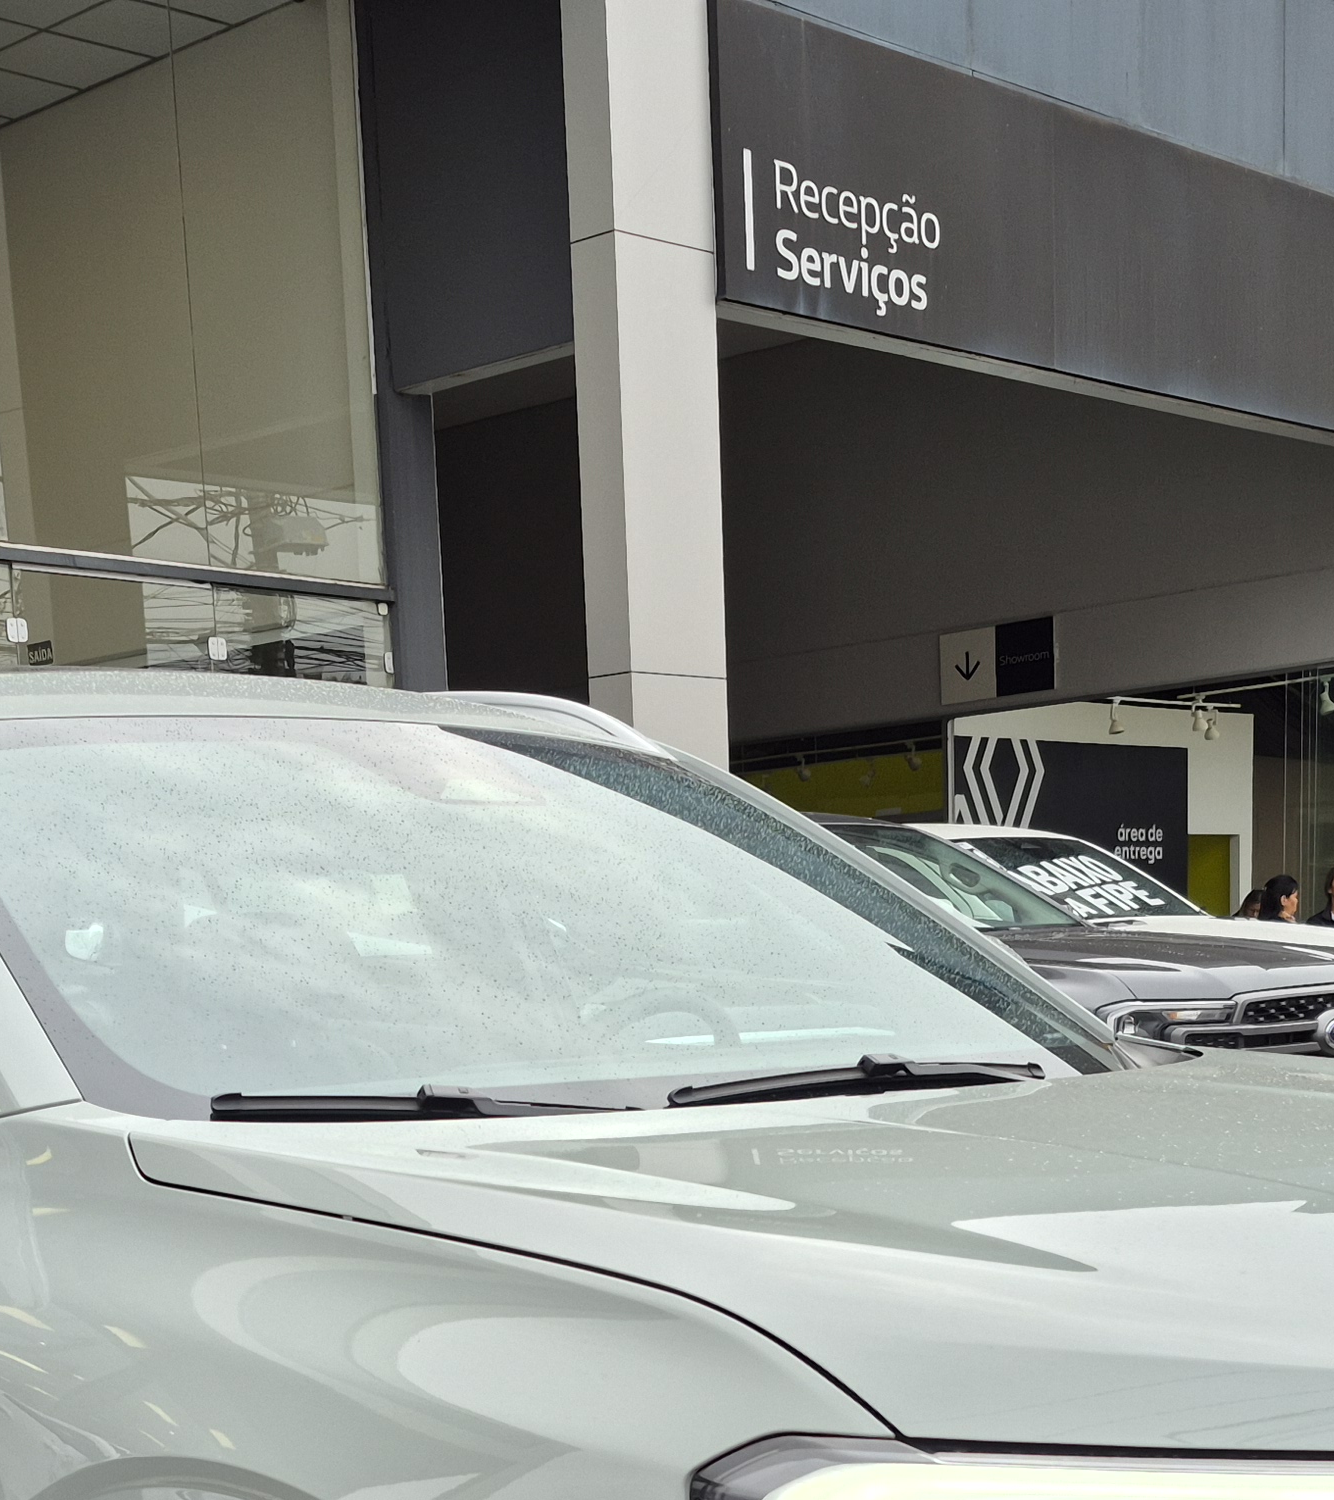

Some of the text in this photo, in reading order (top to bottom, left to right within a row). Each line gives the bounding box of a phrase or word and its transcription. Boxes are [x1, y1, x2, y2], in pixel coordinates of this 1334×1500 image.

[773, 158, 941, 254] Recepção
[774, 228, 928, 317] Serviços
[28, 646, 53, 664] SAÍDA
[998, 651, 1050, 666] Showroom
[1117, 823, 1164, 842] área de
[1113, 844, 1163, 865] entrega
[1075, 880, 1166, 916] FIPE
